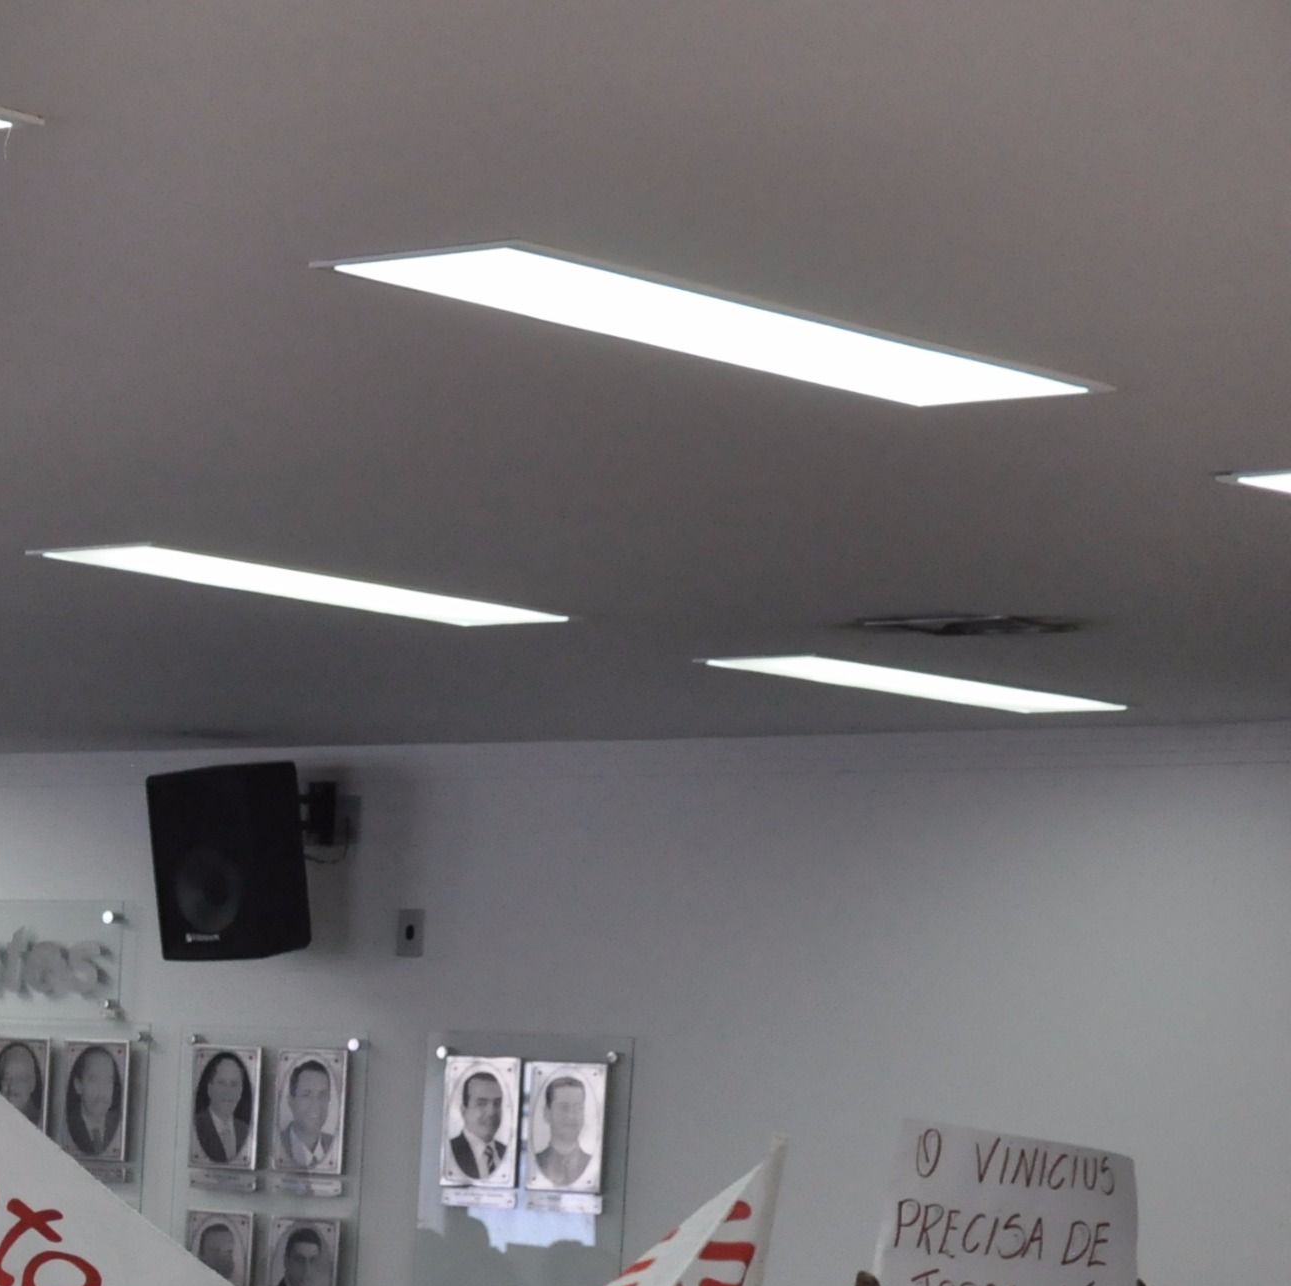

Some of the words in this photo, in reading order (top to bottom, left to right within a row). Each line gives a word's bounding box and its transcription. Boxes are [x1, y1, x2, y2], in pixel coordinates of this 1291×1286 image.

[975, 1137, 1116, 1196] VINICIUS
[893, 1198, 1045, 1260] PRECISA
[1061, 1220, 1111, 1267] DE
